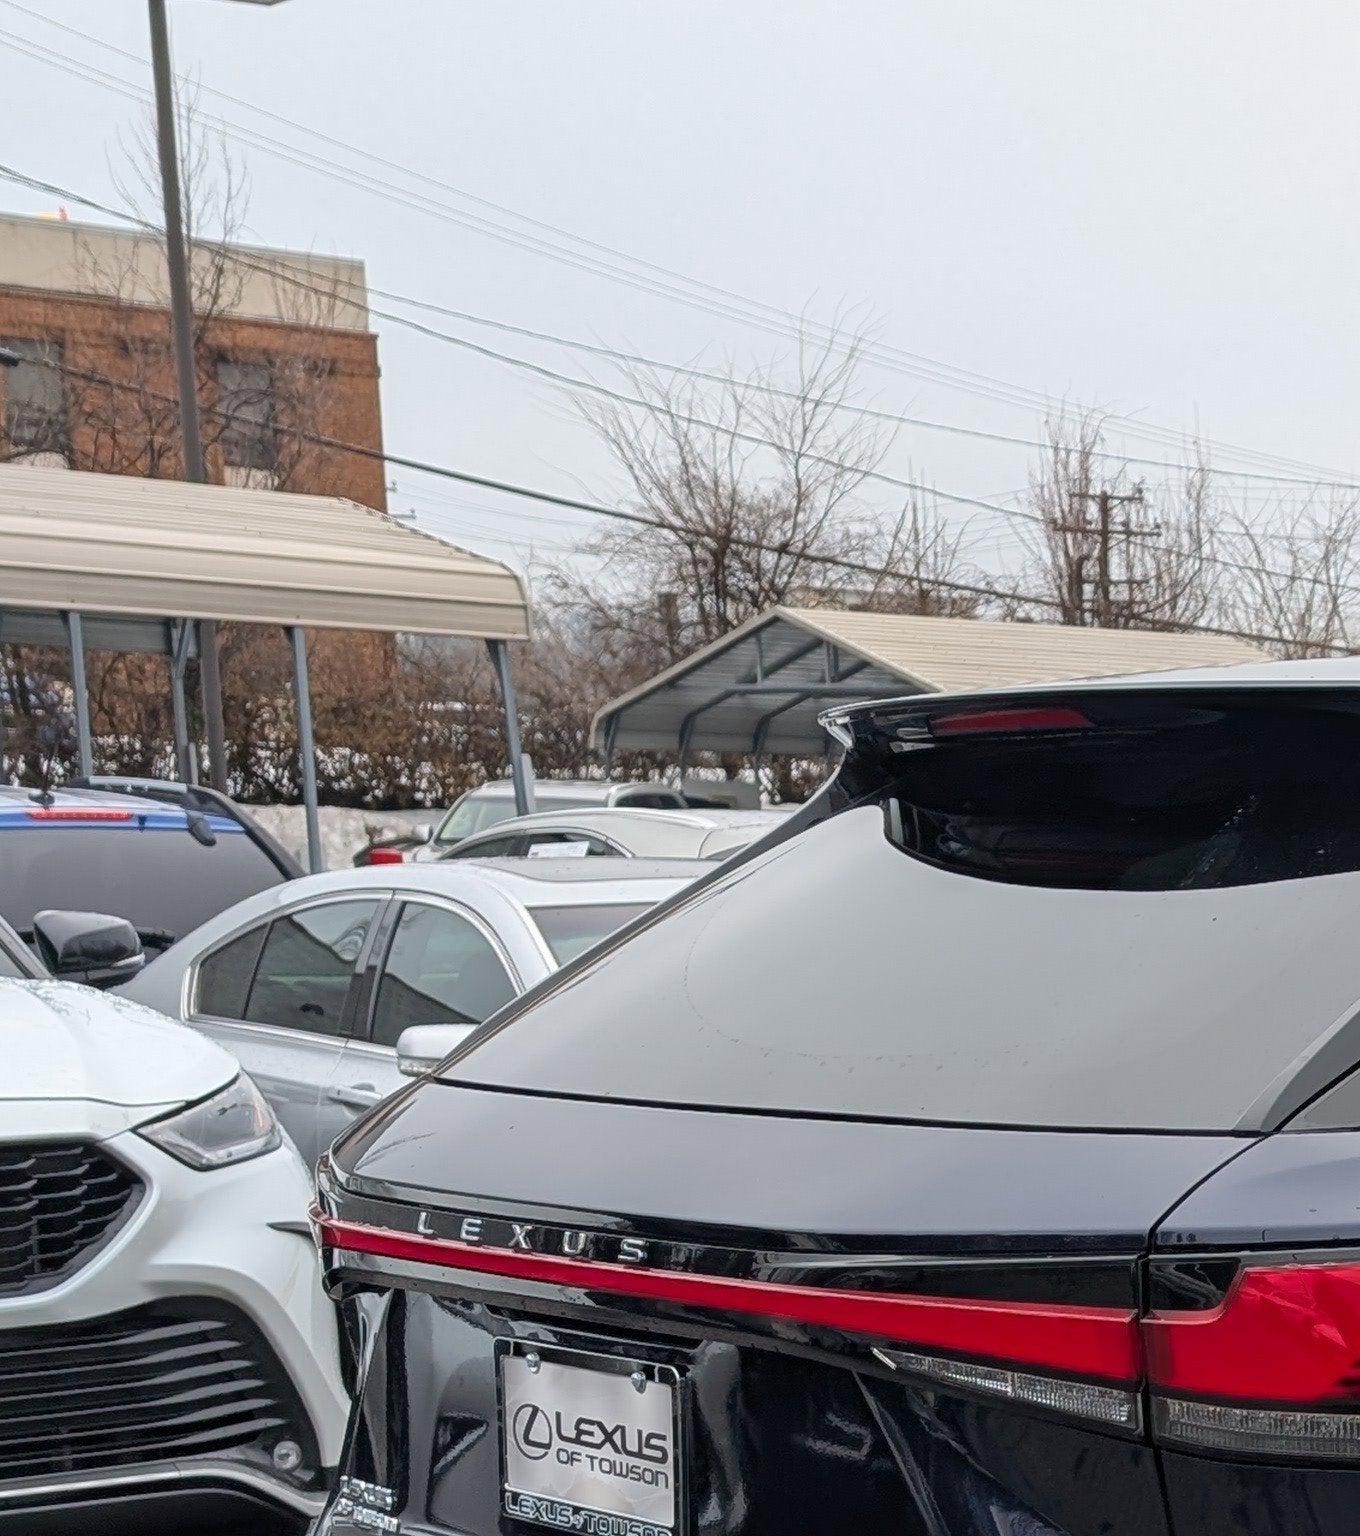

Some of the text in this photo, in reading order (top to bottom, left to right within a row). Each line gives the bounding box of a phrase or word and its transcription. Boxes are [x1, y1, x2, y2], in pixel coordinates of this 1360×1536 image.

[416, 1211, 648, 1263] LEXUS
[555, 1411, 670, 1465] LEXUS
[556, 1448, 670, 1489] OF TOWSON
[505, 1492, 574, 1528] LEXUS
